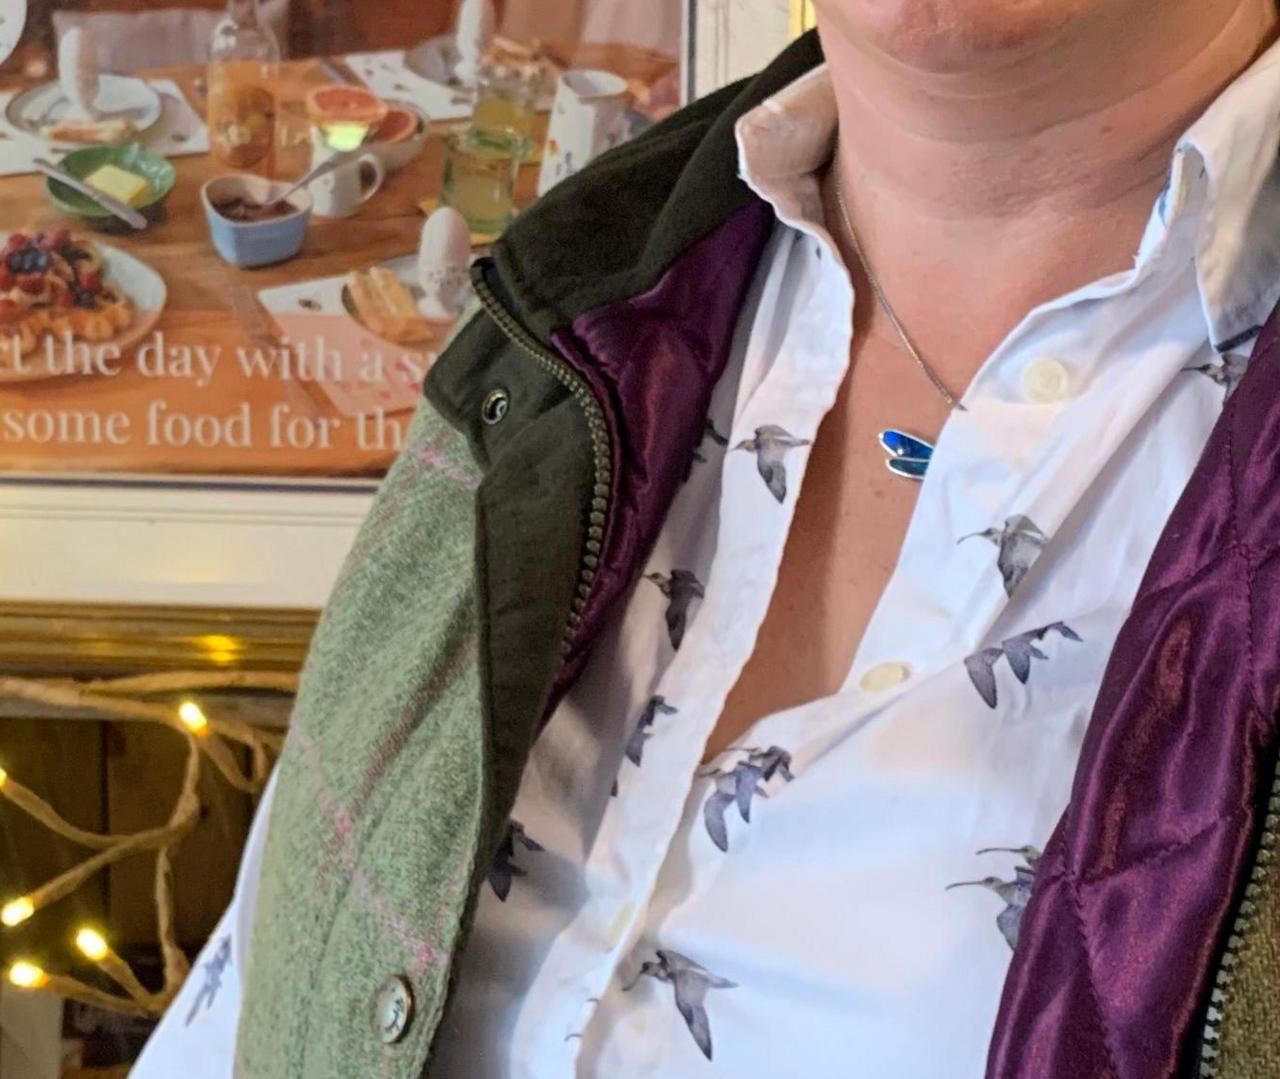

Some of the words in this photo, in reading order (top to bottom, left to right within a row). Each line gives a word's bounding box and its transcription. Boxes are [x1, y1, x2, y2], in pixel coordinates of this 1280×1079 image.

[44, 329, 121, 376] the
[137, 330, 222, 386] day
[236, 333, 343, 382] with
[359, 352, 385, 383] a
[3, 407, 130, 446] some
[147, 401, 252, 448] food
[270, 403, 343, 450] for
